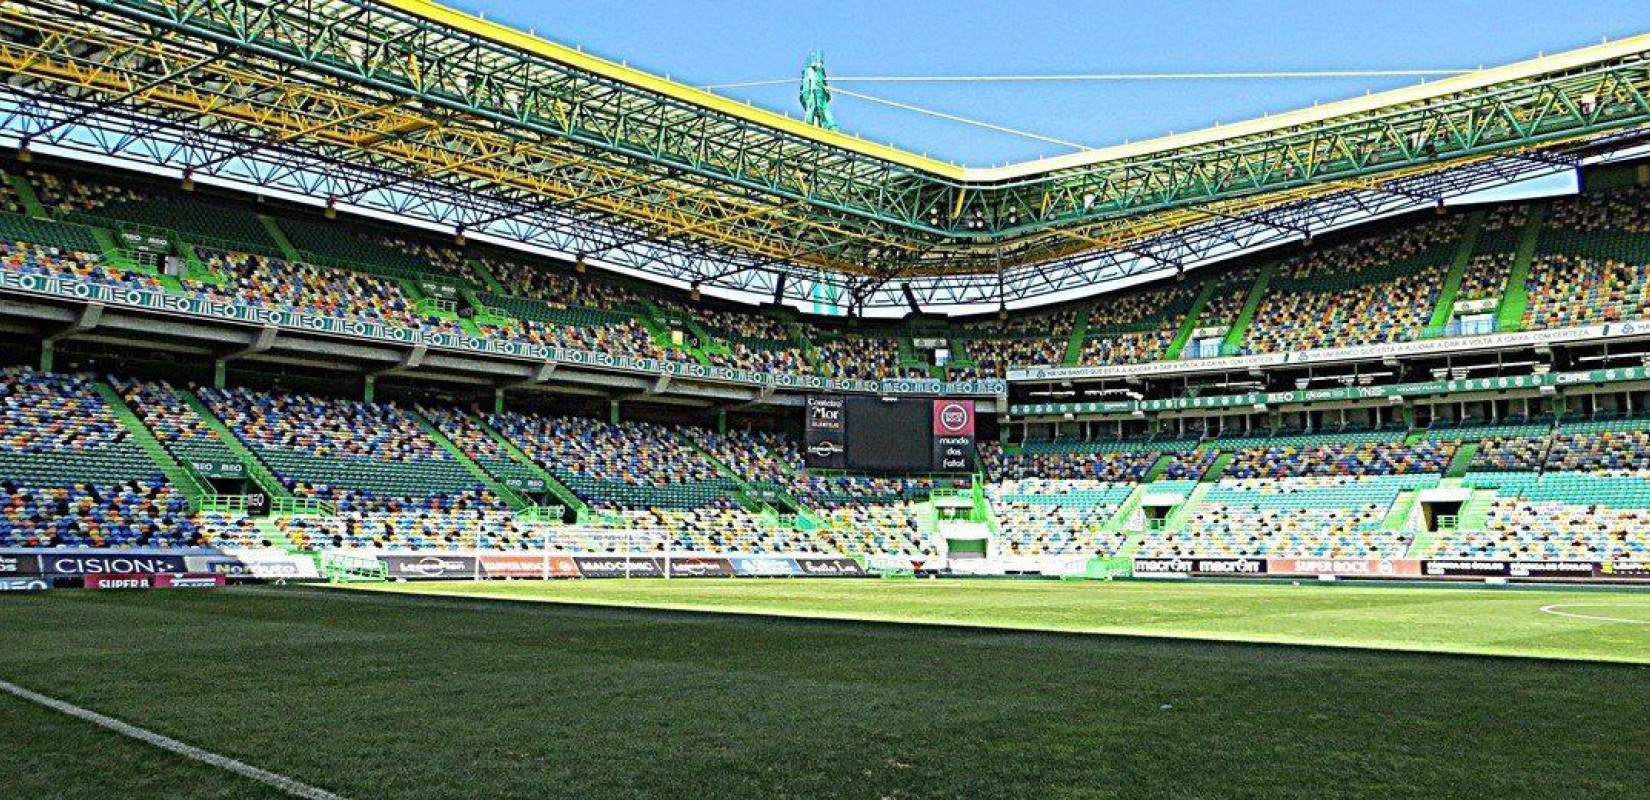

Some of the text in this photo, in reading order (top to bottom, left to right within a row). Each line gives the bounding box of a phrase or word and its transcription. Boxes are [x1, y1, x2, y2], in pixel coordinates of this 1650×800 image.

[0, 271, 1004, 393] EO MEO MEO MEO MEO MEO MEO MEO MEO MEO MEO MEO MEO MEO MEO MEO MEO MEO MEO MEO MEO MEO MEO MEO MEO MEO MEO MEO
[55, 559, 154, 573] CISION
